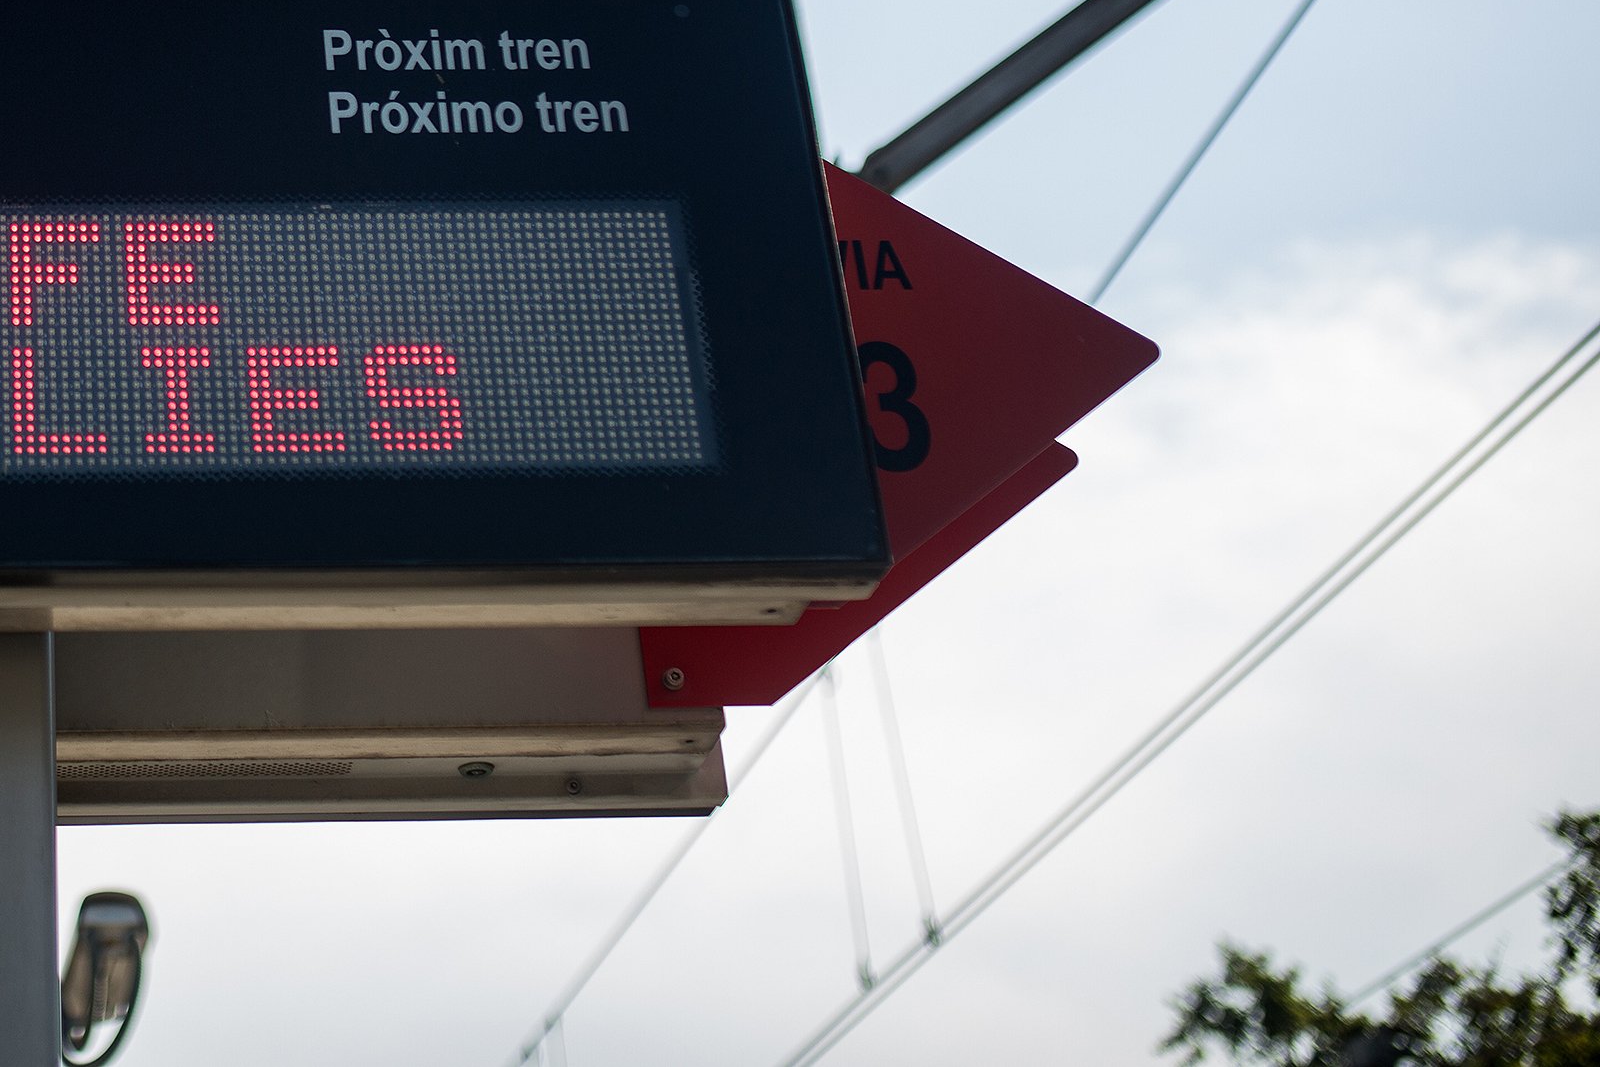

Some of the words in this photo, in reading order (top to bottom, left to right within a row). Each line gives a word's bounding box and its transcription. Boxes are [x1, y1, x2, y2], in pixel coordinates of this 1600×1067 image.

[323, 28, 488, 73] Pròxim
[498, 30, 593, 73] tren
[328, 91, 526, 136] Próximo
[535, 92, 631, 135] tren
[857, 341, 932, 473] 3
